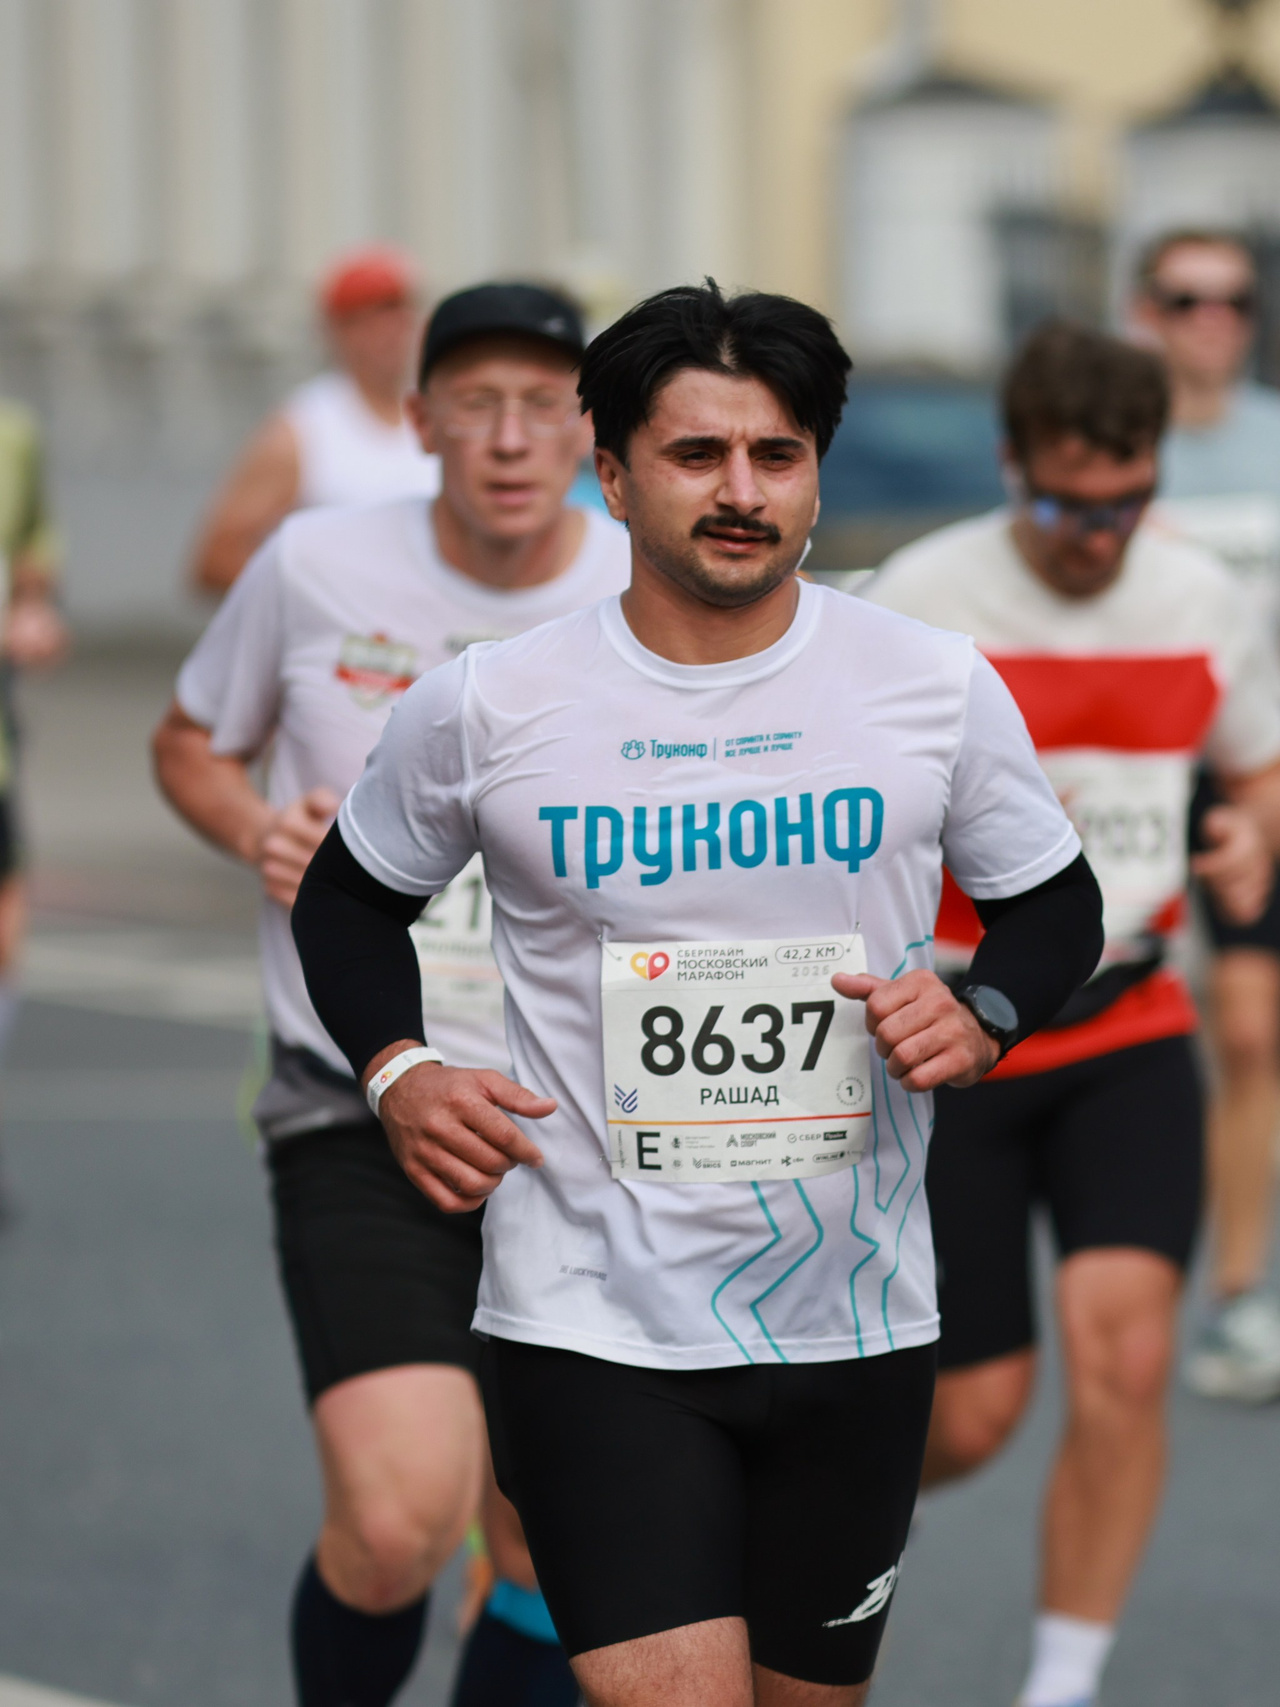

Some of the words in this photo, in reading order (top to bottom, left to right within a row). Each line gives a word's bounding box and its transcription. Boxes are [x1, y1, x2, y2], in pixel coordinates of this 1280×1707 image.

[649, 739, 708, 760] Труконф
[677, 948, 744, 958] СБЕРПРАЙМ
[783, 948, 811, 961] 42,2
[677, 957, 768, 969] МОСКОВСКИЙ
[677, 970, 745, 982] МАРАФОН
[640, 999, 836, 1077] 8637
[700, 1085, 780, 1106] РАШАД
[845, 1085, 853, 1097] 1
[799, 1133, 821, 1141] СБЕР
[636, 1131, 662, 1171] E
[738, 1159, 772, 1167] магнит
